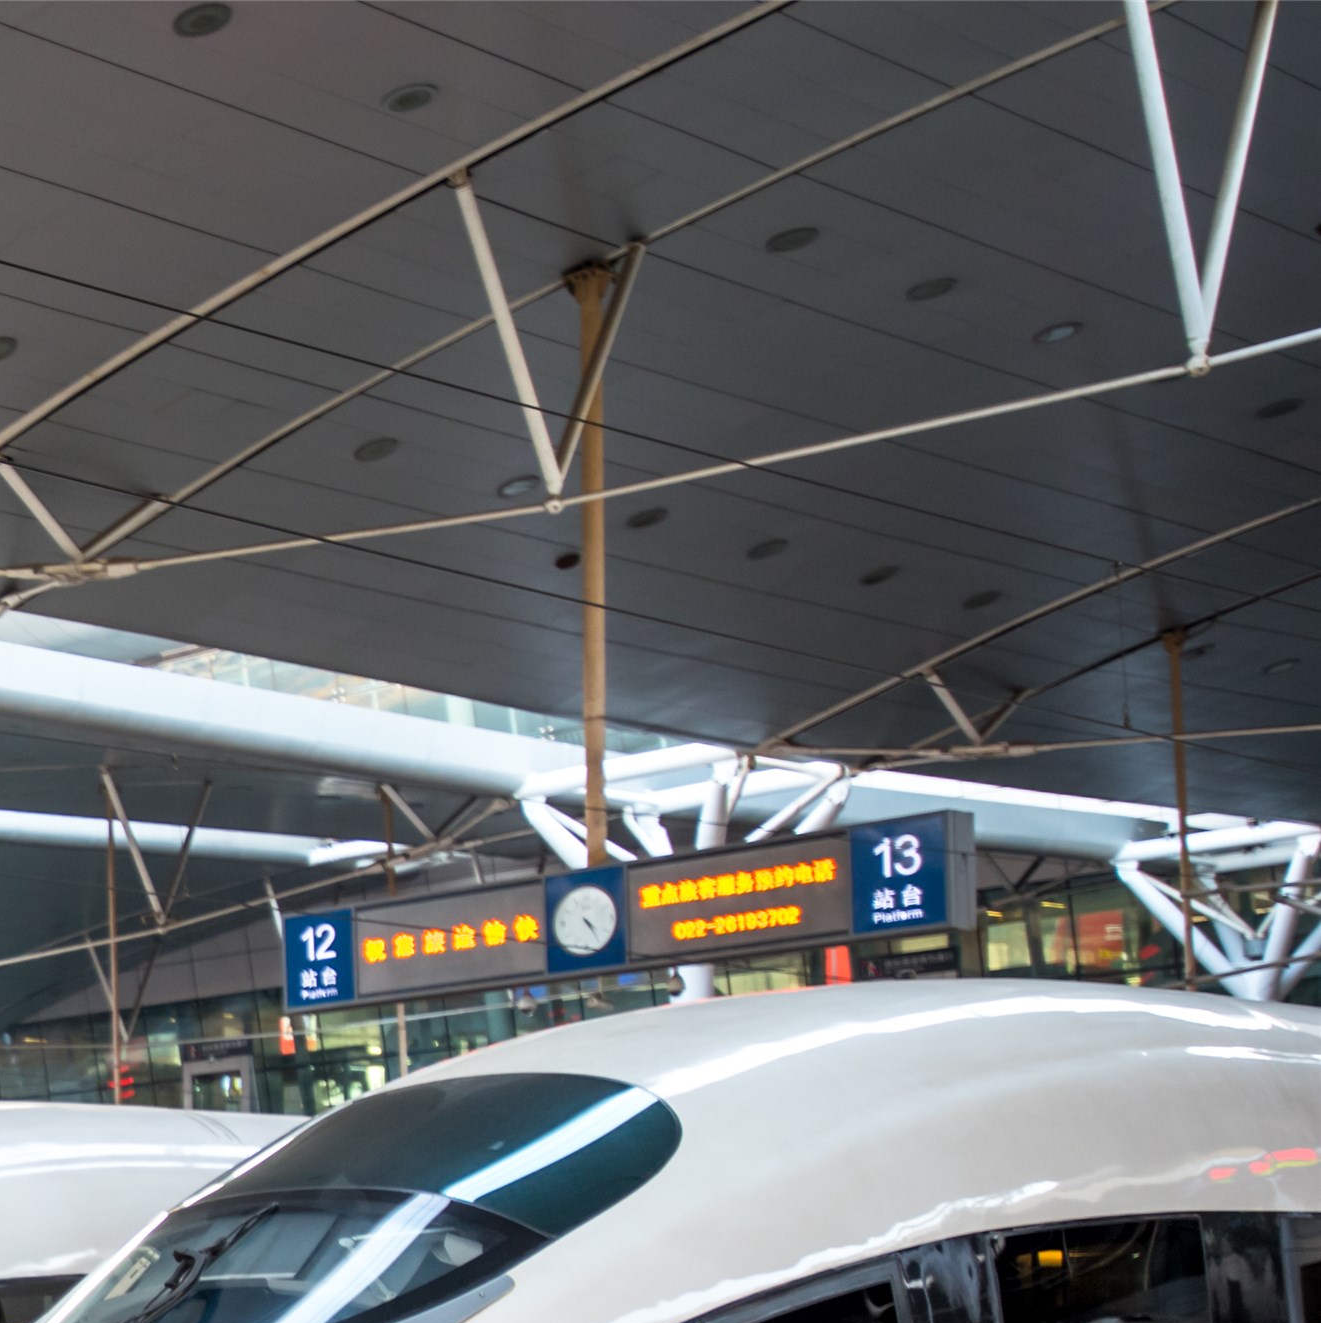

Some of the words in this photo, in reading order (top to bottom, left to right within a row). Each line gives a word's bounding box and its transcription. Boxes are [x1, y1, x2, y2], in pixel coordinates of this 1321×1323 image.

[871, 833, 923, 878] 13
[872, 883, 924, 910] 站台
[872, 907, 925, 925] Platform
[299, 922, 338, 963] 12
[299, 965, 339, 989] 站台
